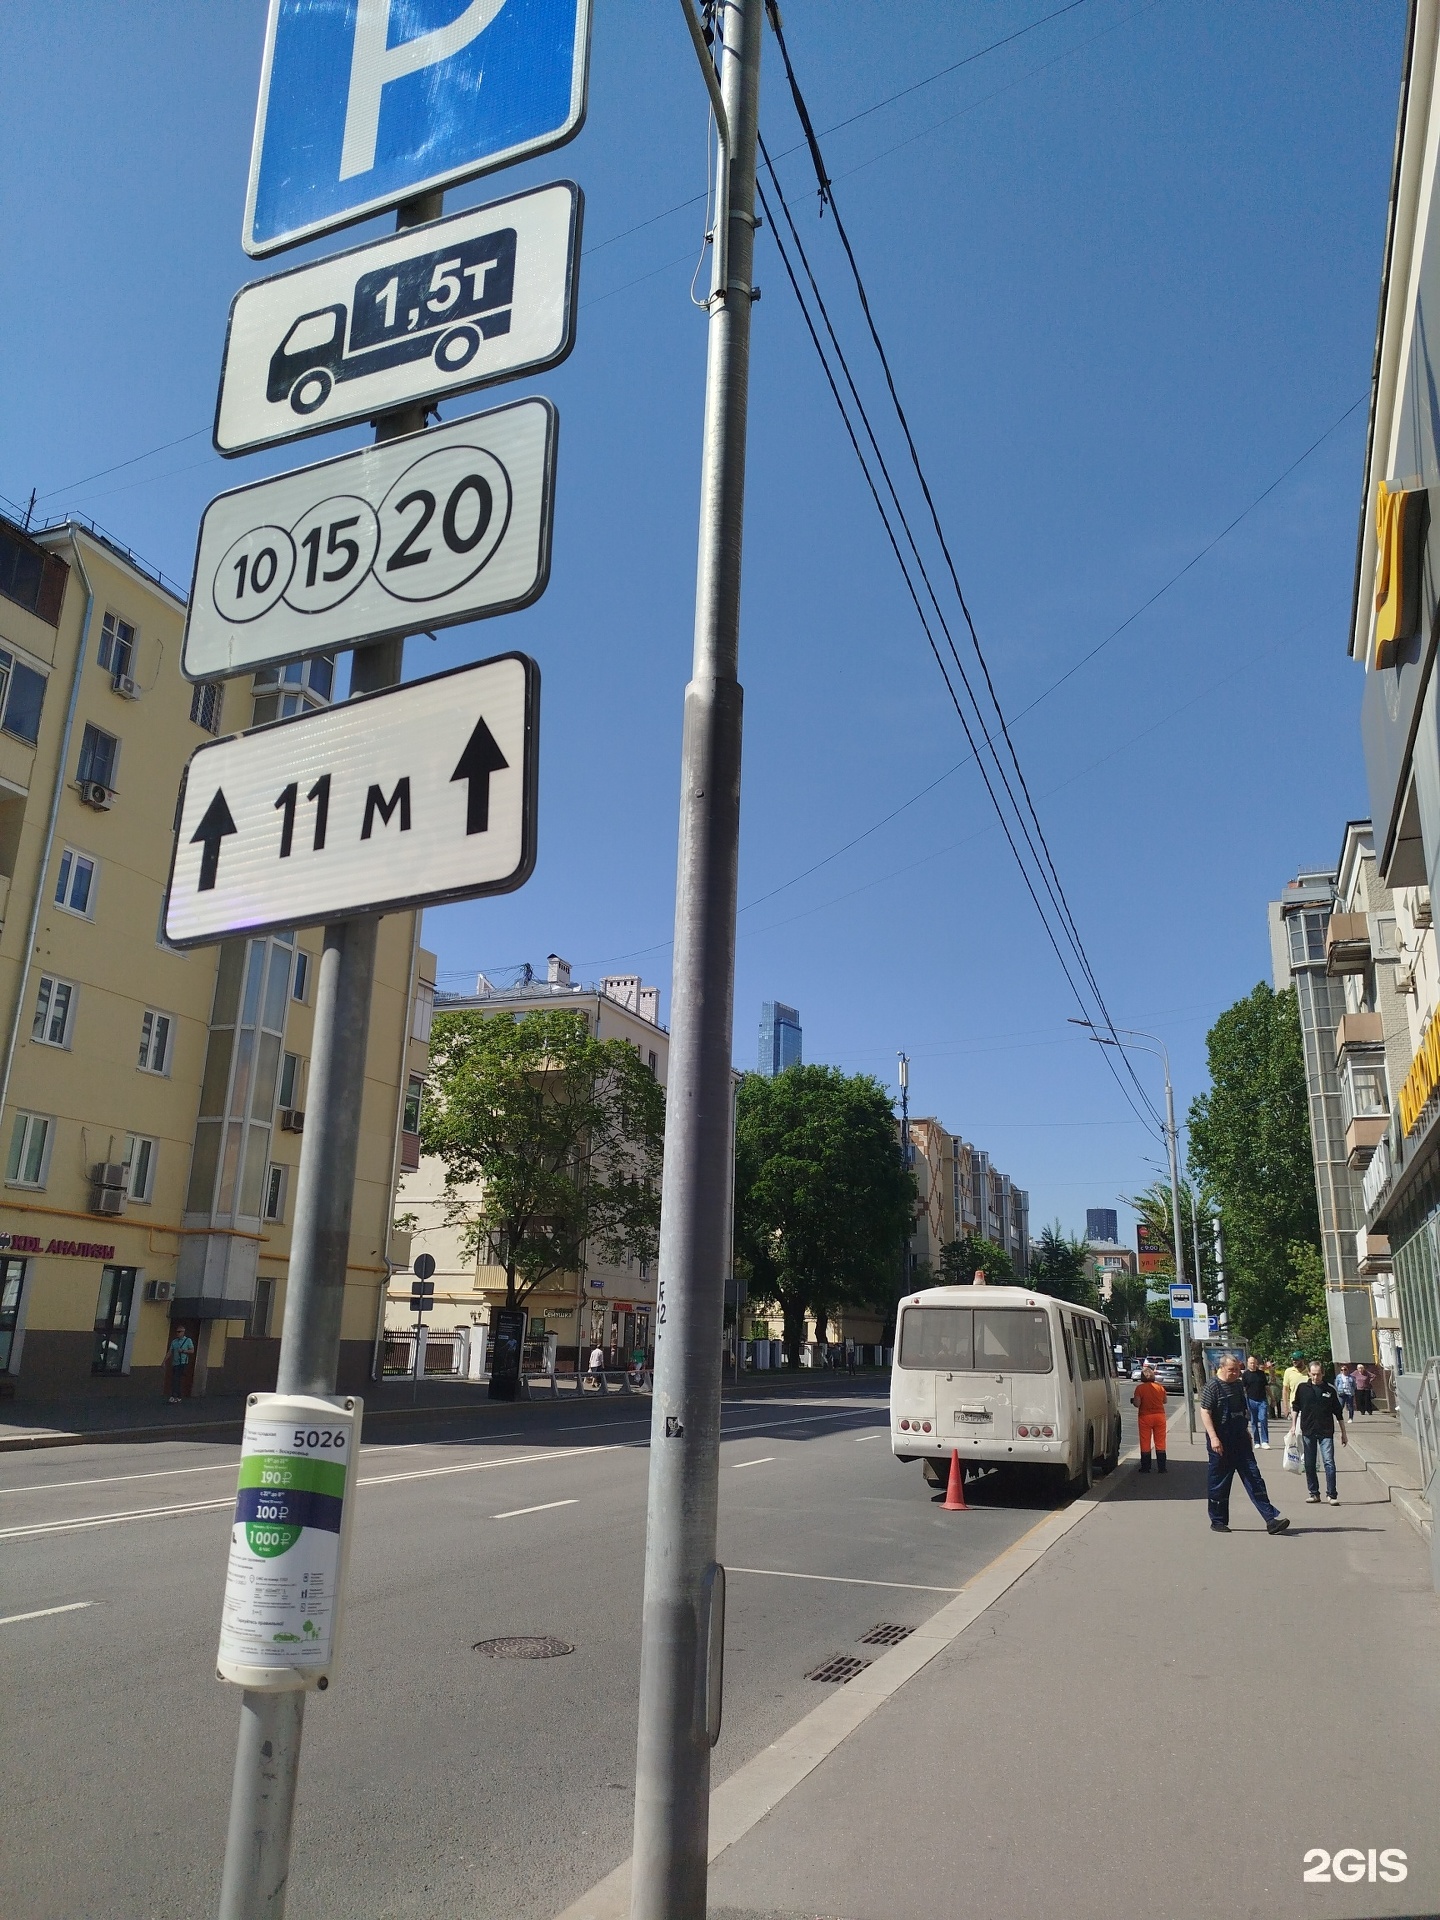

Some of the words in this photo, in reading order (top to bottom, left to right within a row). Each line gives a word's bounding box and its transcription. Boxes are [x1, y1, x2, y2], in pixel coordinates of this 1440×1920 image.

[233, 546, 278, 599] 10
[301, 515, 360, 587] 15
[386, 473, 493, 572] 20
[274, 773, 331, 859] 11
[45, 1239, 115, 1259] АНАЛИЗЫ
[293, 1430, 346, 1448] 5026
